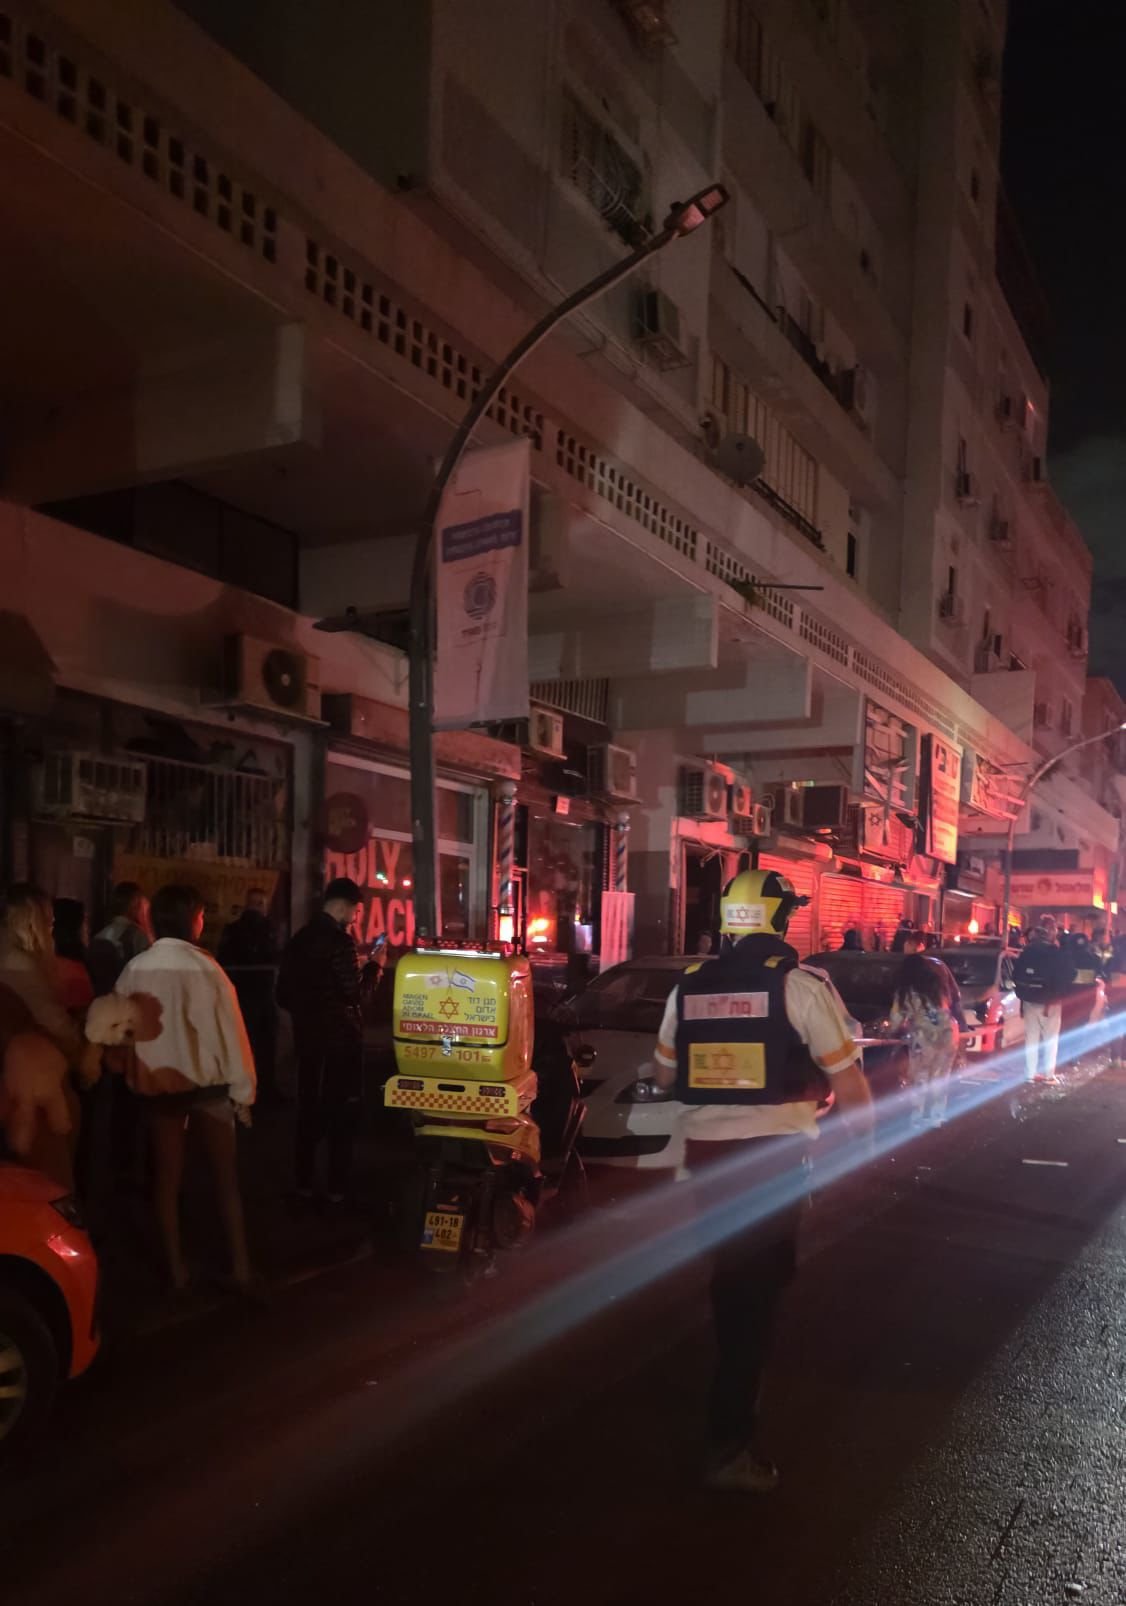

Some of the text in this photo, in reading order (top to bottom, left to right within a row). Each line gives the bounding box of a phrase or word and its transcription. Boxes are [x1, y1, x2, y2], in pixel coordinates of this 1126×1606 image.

[484, 998, 496, 1006] מגן
[475, 1006, 496, 1014] אדום
[463, 1013, 496, 1022] בישראל
[403, 1022, 434, 1033] הלאומי
[472, 1027, 496, 1037] ארגון
[404, 1046, 436, 1059] 5497
[456, 1050, 480, 1062] 101
